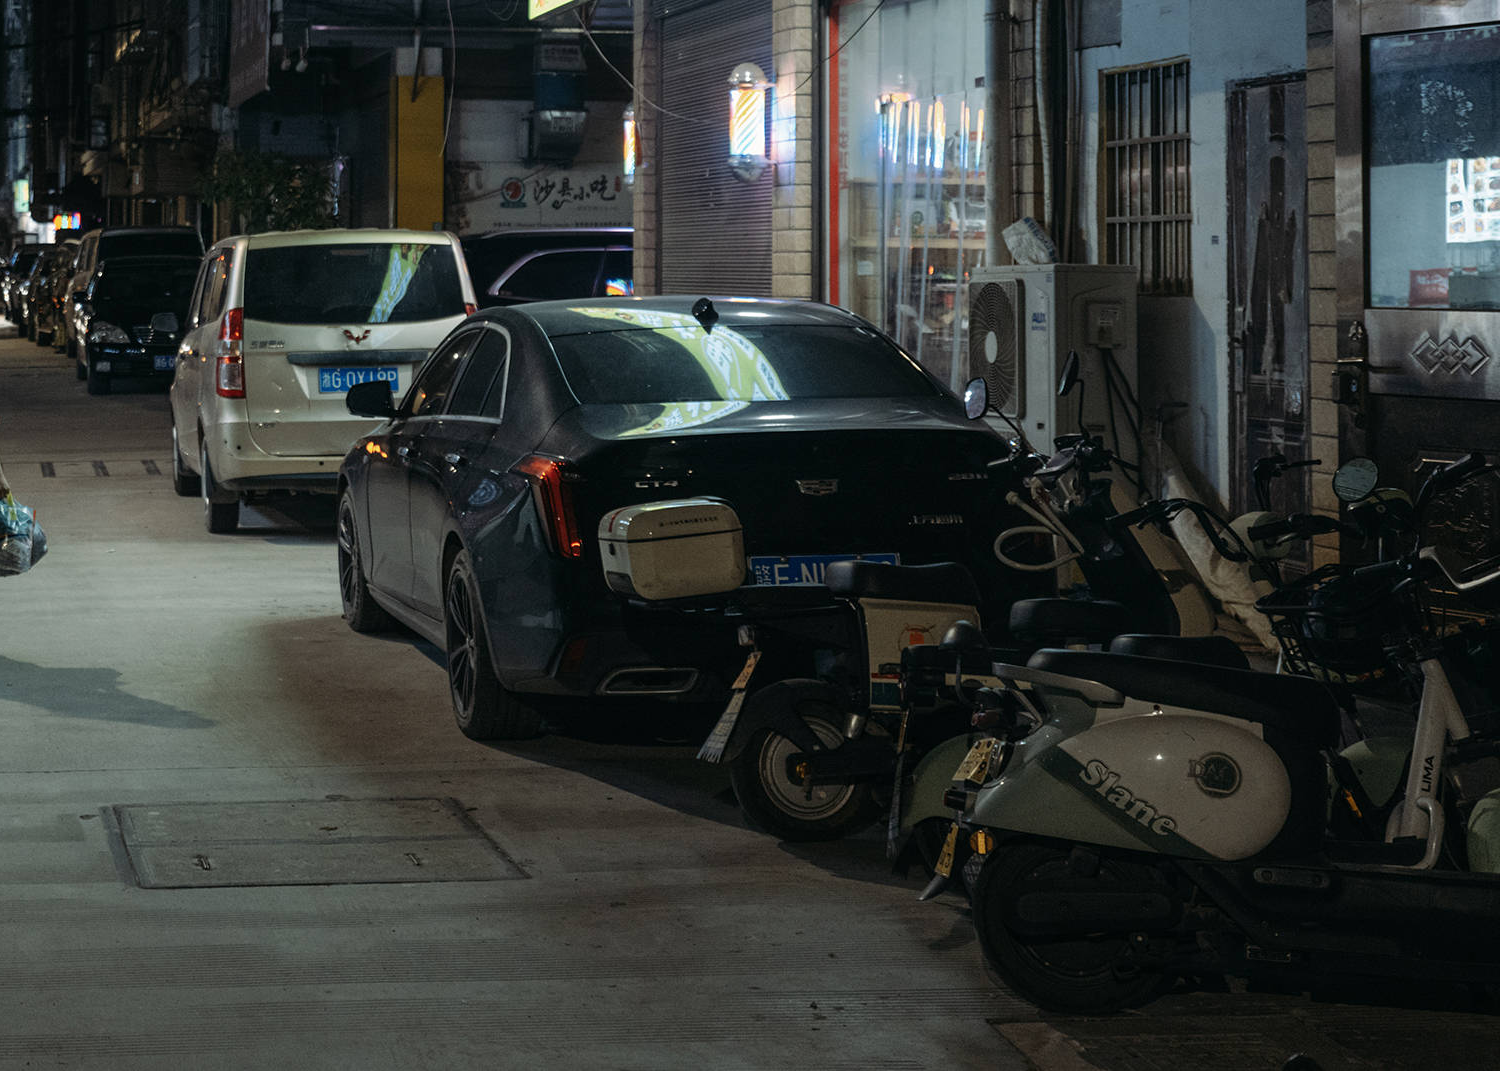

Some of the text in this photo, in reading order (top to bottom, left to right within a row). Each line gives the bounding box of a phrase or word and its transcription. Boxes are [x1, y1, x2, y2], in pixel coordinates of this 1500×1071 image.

[533, 174, 617, 210] 沙县小吃
[1421, 756, 1435, 792] LIMA
[1078, 759, 1177, 836] Slane
